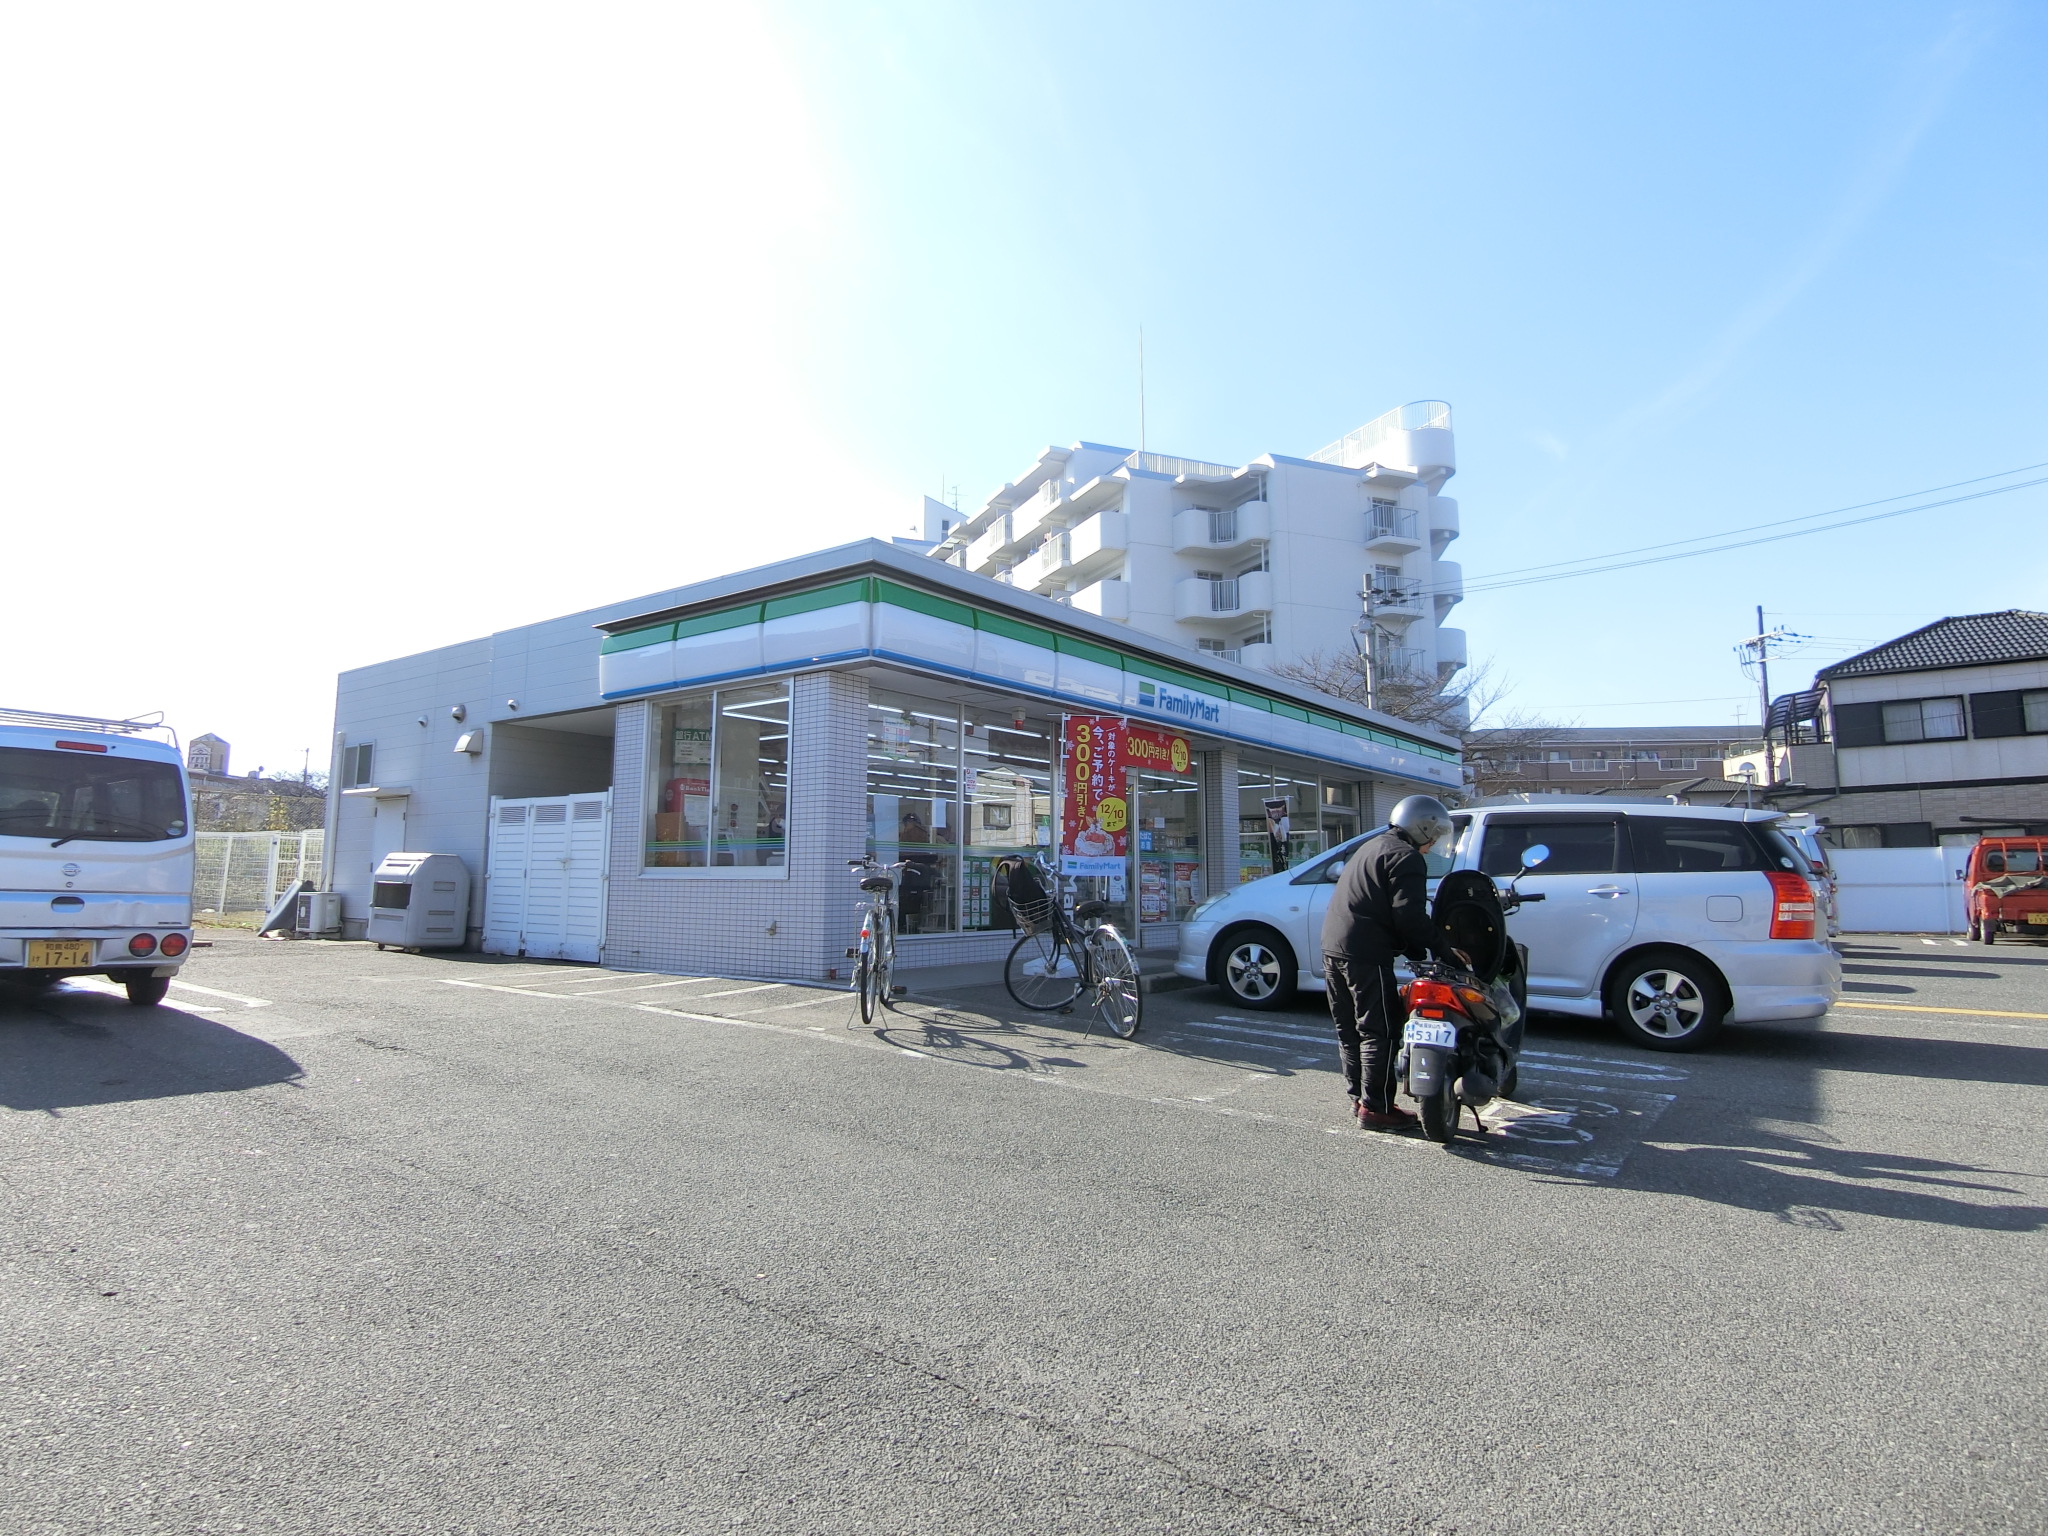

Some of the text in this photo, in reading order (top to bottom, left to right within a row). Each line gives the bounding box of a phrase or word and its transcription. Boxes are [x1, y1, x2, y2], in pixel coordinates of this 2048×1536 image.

[1159, 687, 1219, 723] FamilyMart
[1091, 725, 1104, 801] 今、ご予約で
[1100, 803, 1124, 819] 12/10
[1079, 862, 1121, 871] FamilyMart
[45, 951, 90, 966] 17-14
[1415, 1029, 1452, 1044] 5317
